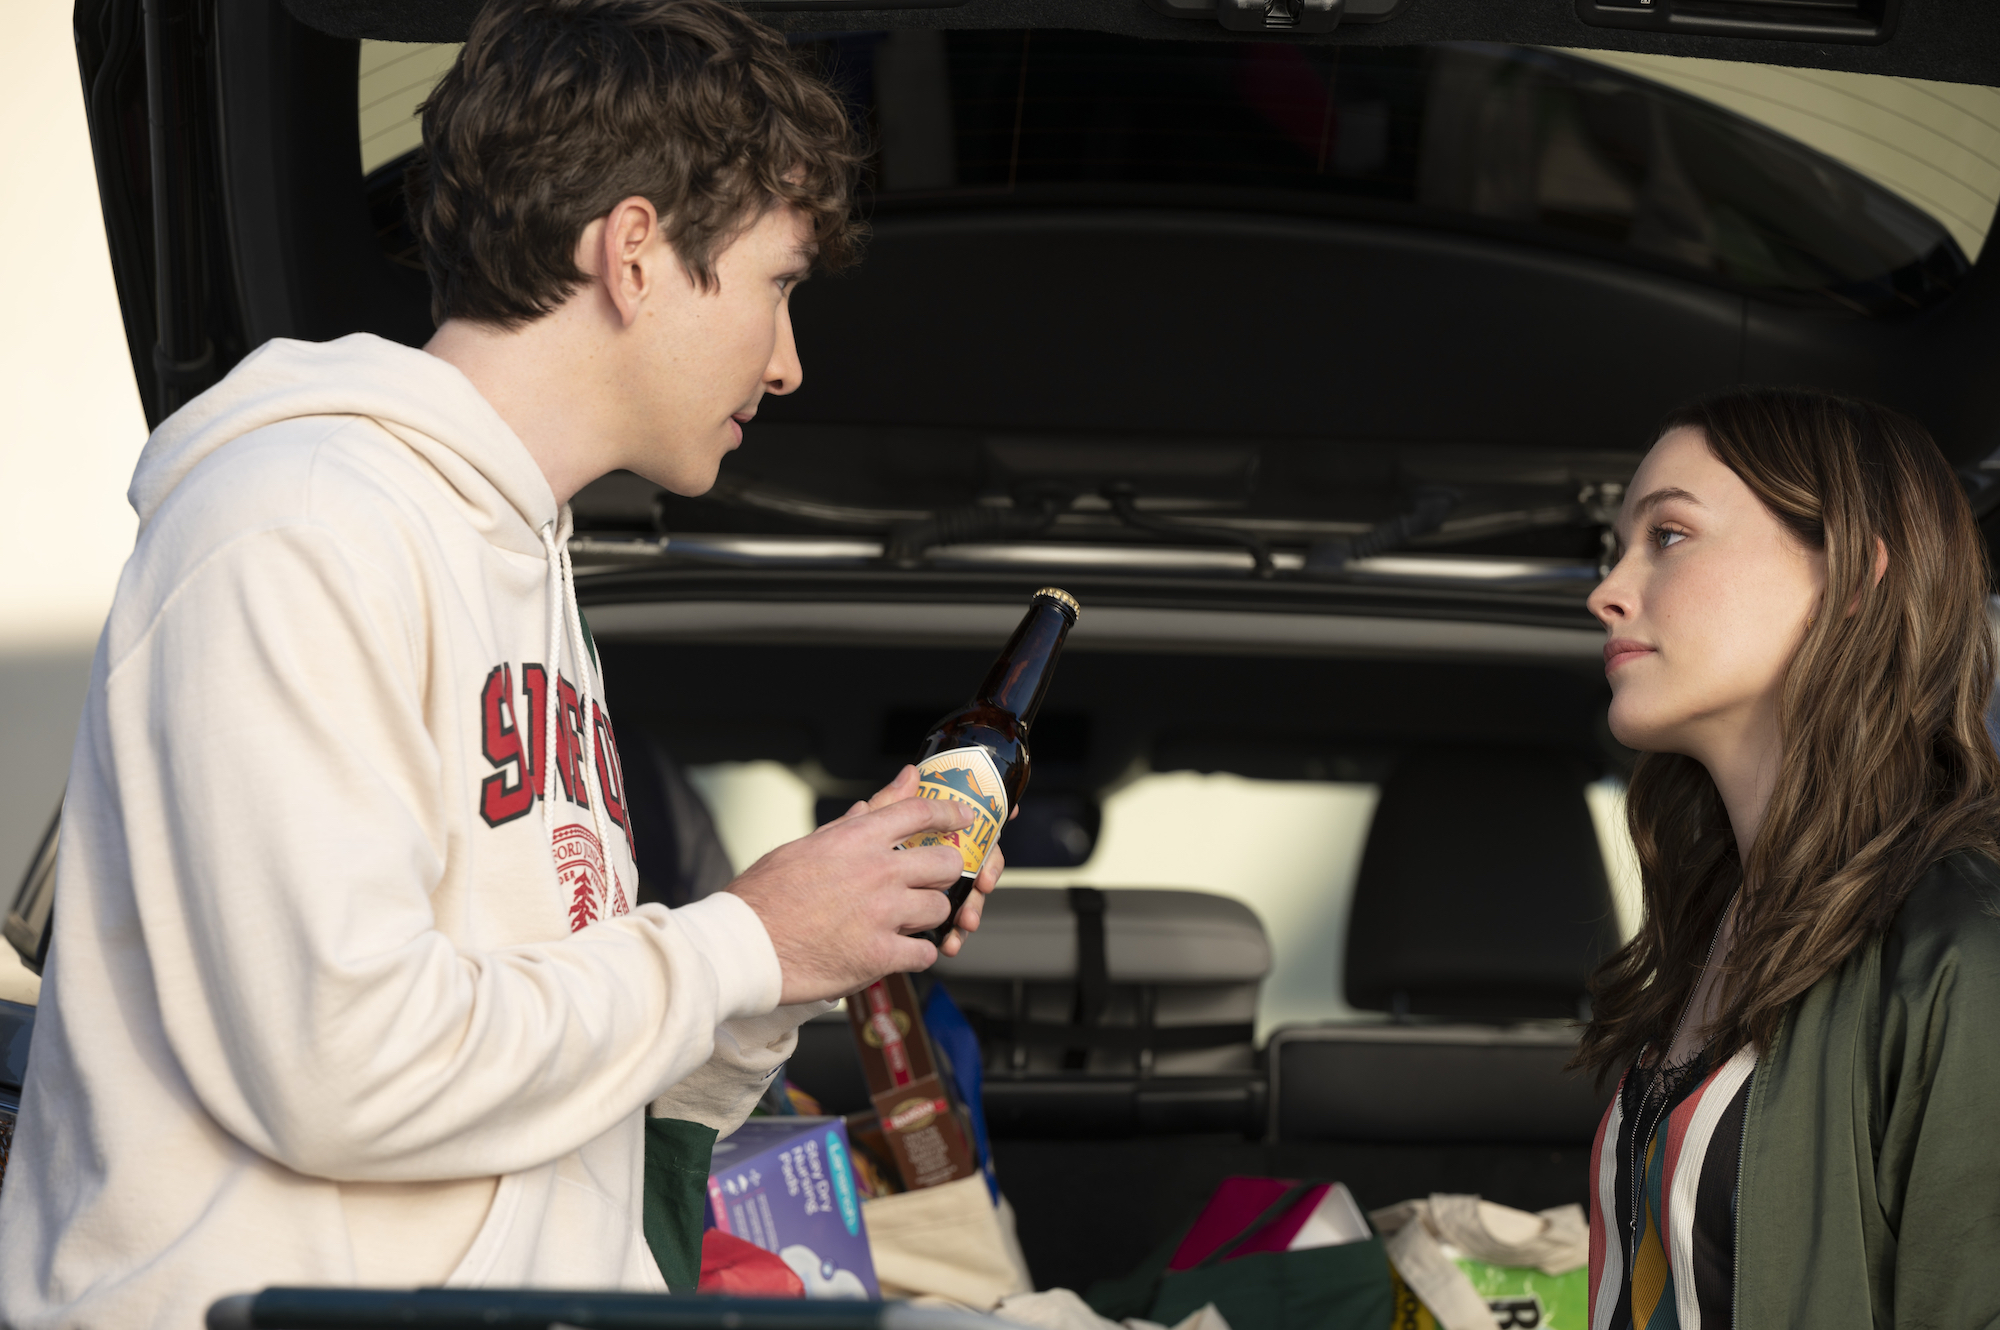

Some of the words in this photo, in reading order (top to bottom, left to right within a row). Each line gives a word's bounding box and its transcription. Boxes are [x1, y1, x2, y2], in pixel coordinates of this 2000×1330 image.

[777, 1151, 800, 1197] Pads
[791, 1145, 819, 1216] Nursing
[803, 1139, 825, 1180] Stay
[815, 1179, 833, 1213] Dry
